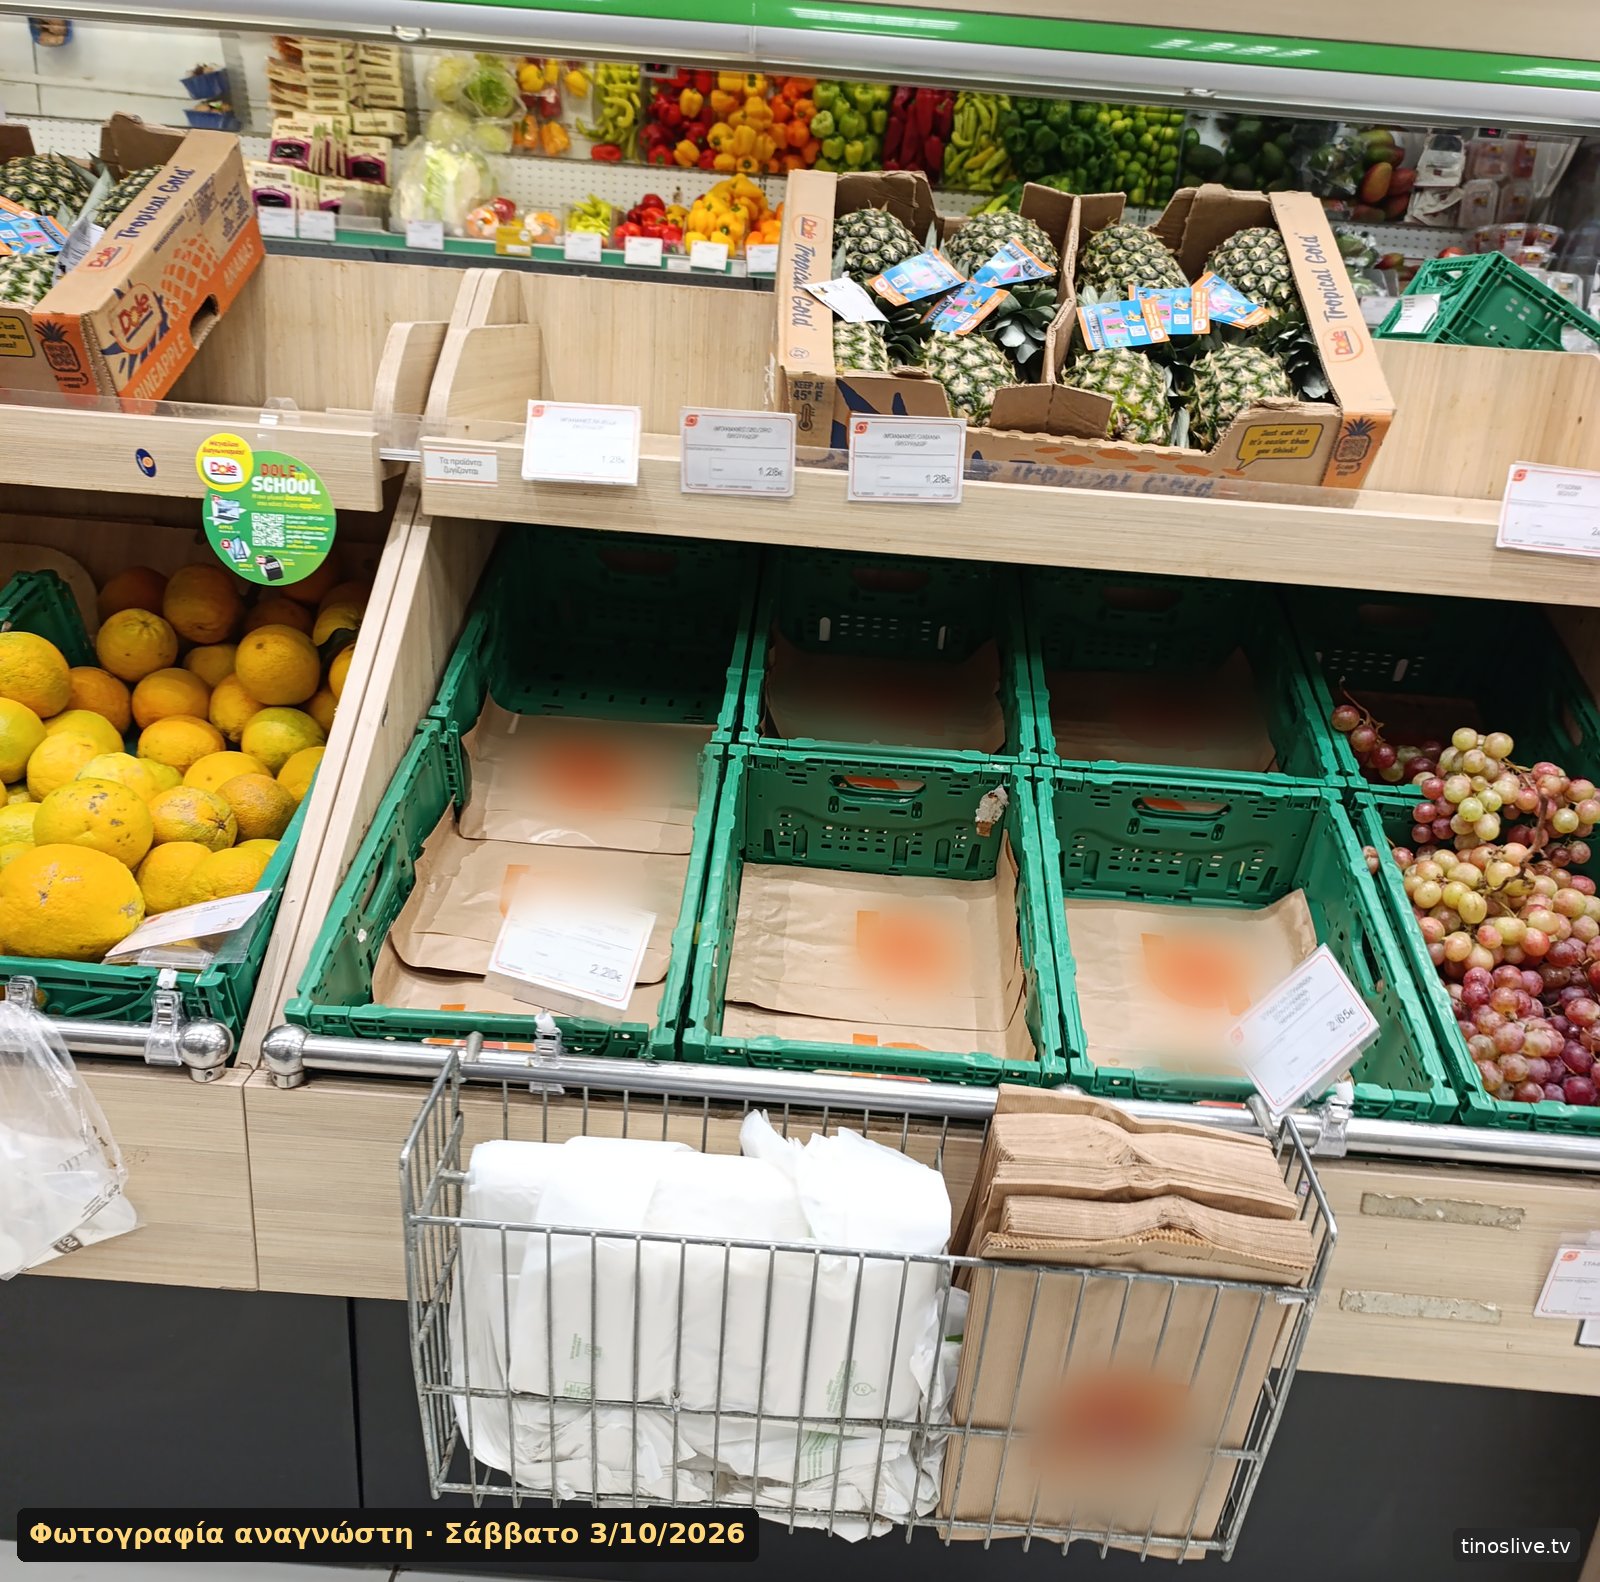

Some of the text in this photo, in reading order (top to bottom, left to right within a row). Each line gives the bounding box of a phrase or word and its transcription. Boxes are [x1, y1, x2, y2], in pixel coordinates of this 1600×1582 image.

[114, 194, 171, 241] Tropical
[157, 166, 196, 193] Gold
[88, 246, 118, 268] Dole
[790, 243, 816, 328] Tropical Gold
[1298, 234, 1348, 323] Tropical Gold
[118, 293, 153, 337] Dole
[1331, 330, 1351, 356] Dole
[134, 333, 189, 404] PINEAPPLE
[793, 390, 823, 401] 45° F
[794, 381, 825, 390] KEEP AT
[210, 461, 237, 474] Dole
[261, 463, 296, 478] DOLE
[439, 456, 449, 465] Τα
[251, 475, 321, 495] SCHOOL
